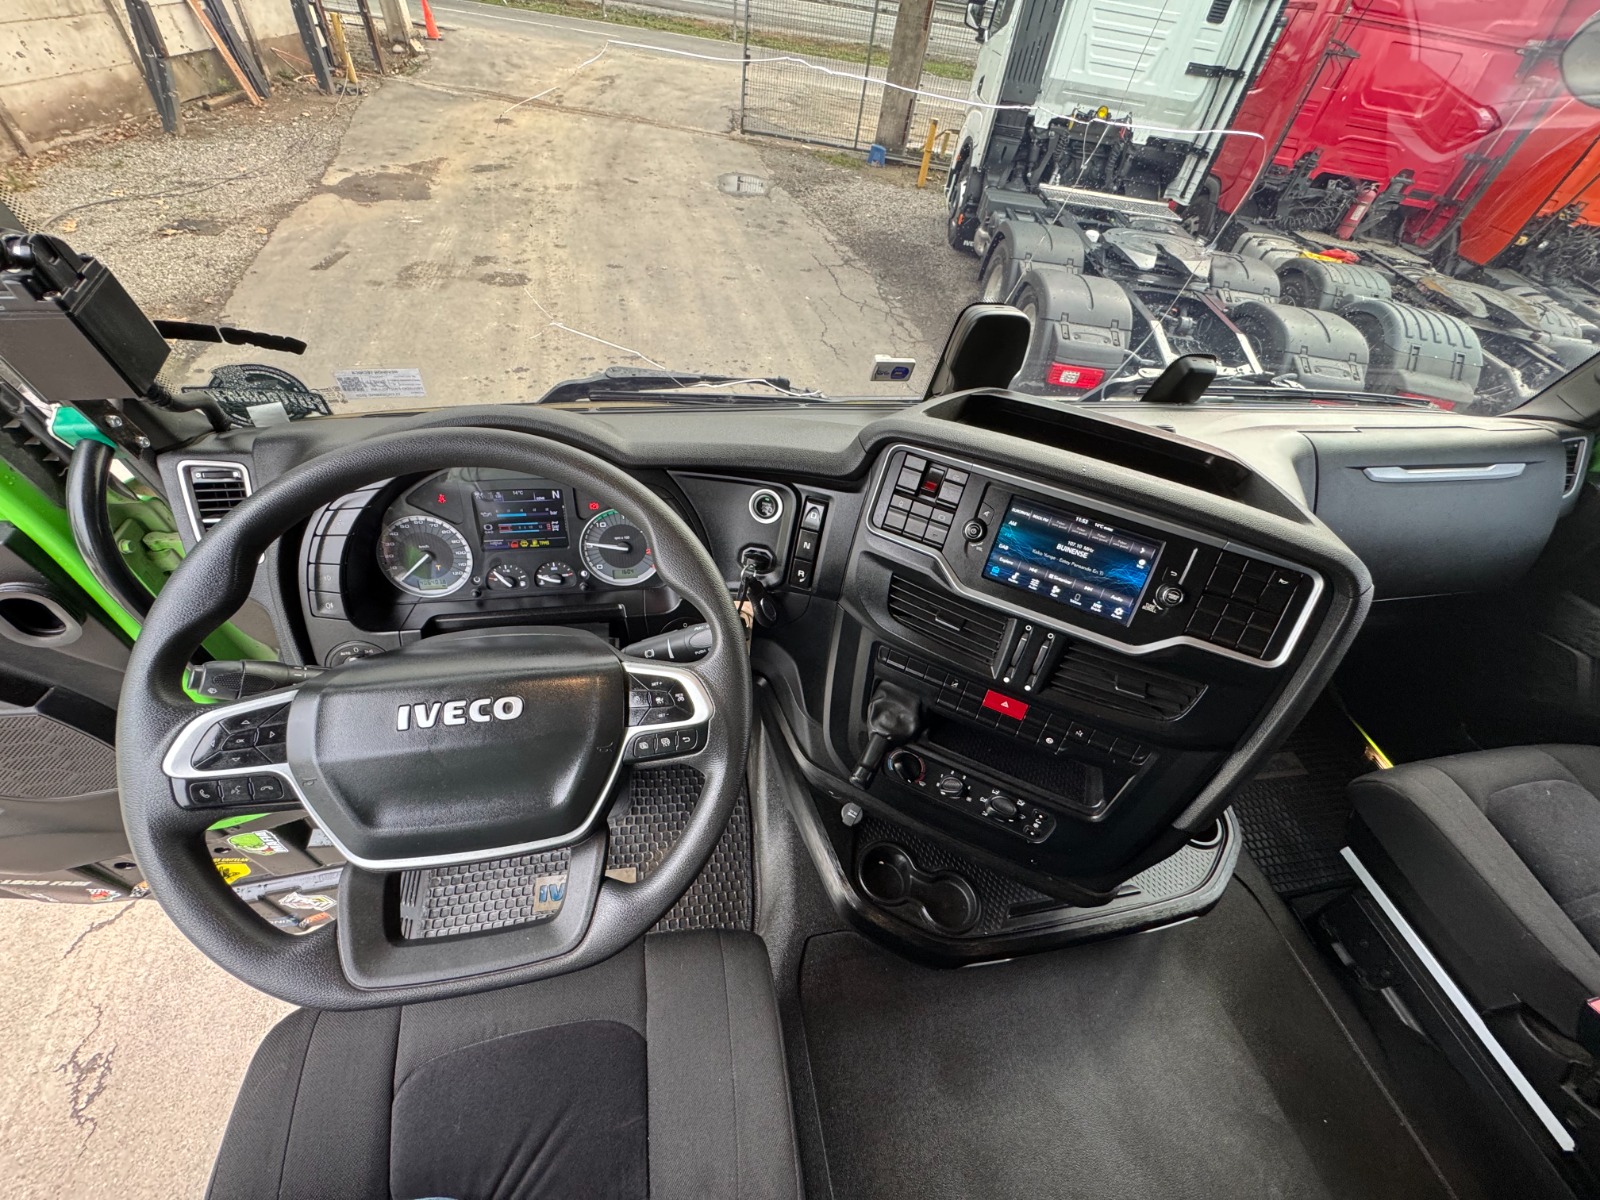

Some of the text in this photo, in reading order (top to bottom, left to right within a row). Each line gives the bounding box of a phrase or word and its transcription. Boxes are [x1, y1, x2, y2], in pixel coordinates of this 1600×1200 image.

[552, 490, 560, 499] N
[803, 541, 811, 549] N
[1056, 543, 1089, 559] BUINENSE
[797, 569, 805, 577] R
[397, 696, 524, 731] IVECO
